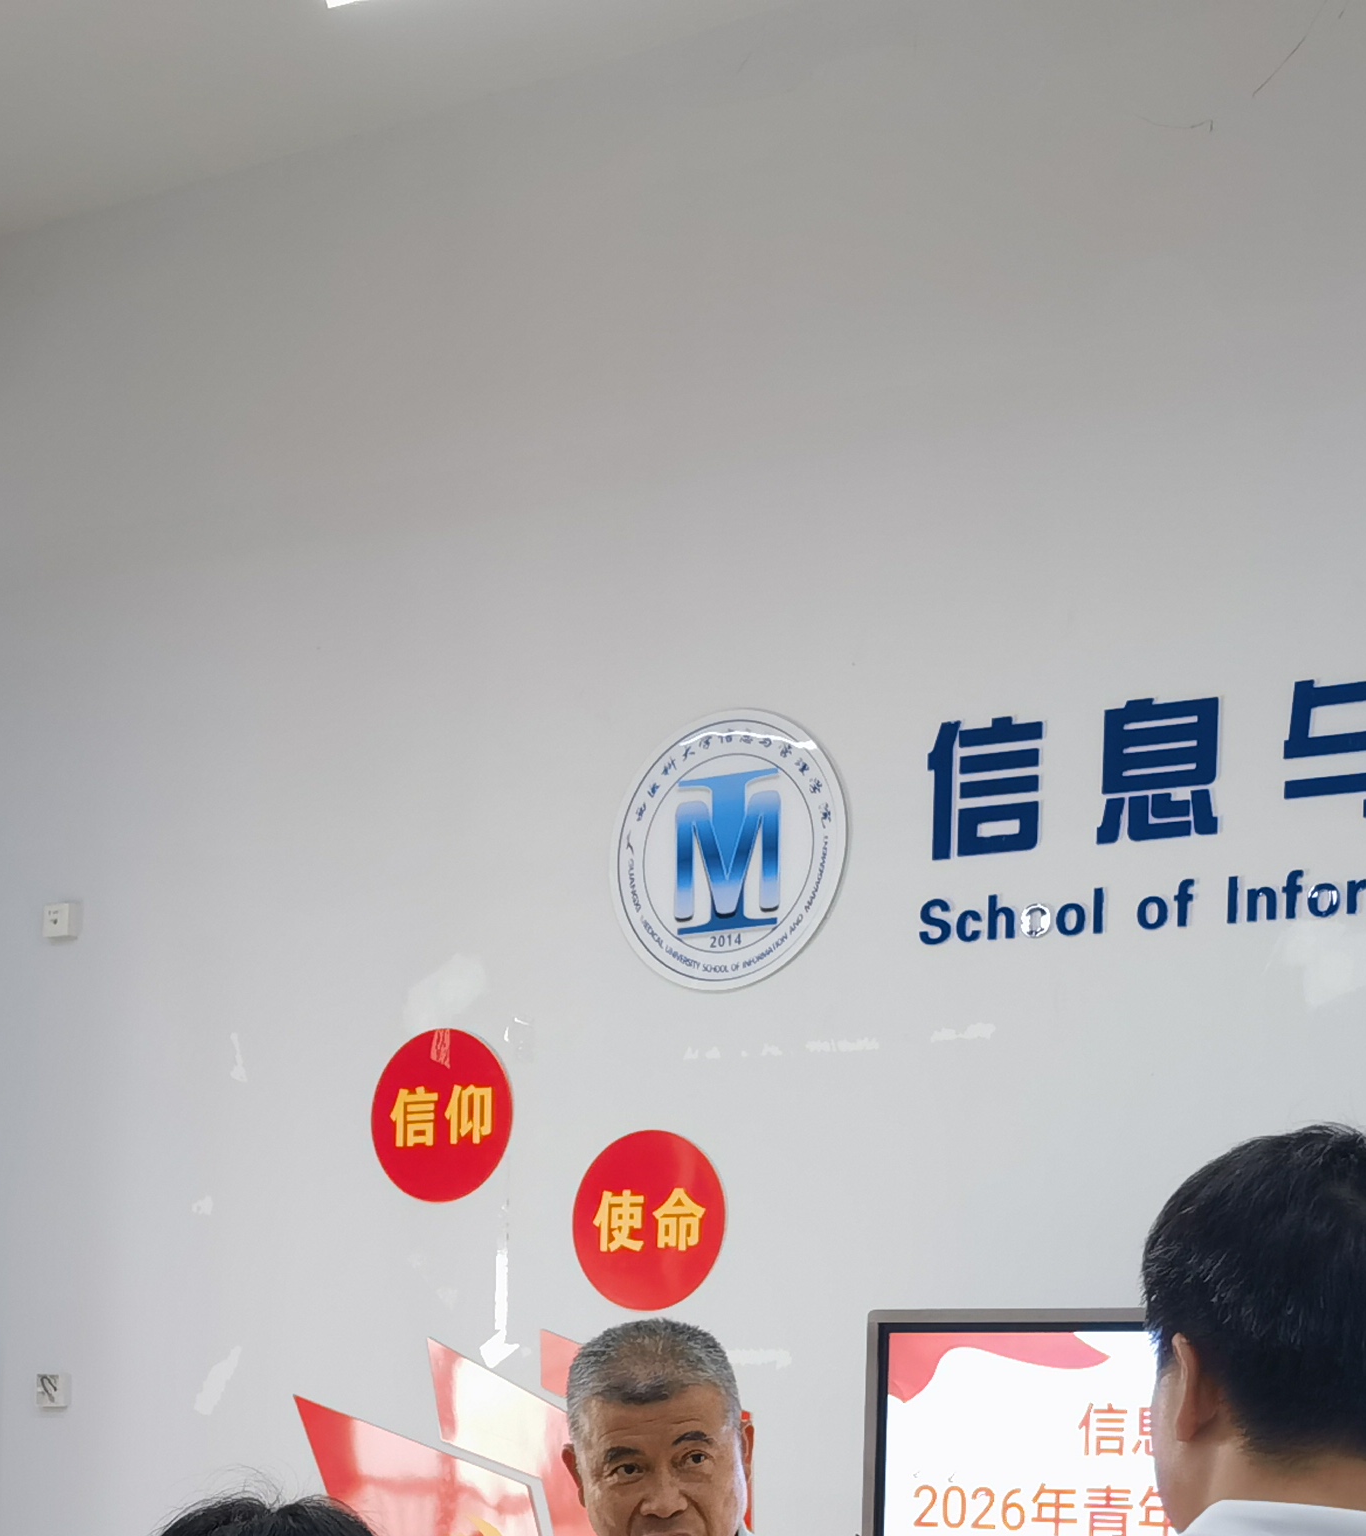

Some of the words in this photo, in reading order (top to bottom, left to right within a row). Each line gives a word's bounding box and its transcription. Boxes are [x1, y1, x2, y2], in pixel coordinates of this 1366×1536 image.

[709, 933, 742, 949] 2014
[918, 886, 1106, 946] School
[1136, 878, 1196, 931] of
[390, 1084, 494, 1148] 信仰
[593, 1187, 706, 1253] 使命
